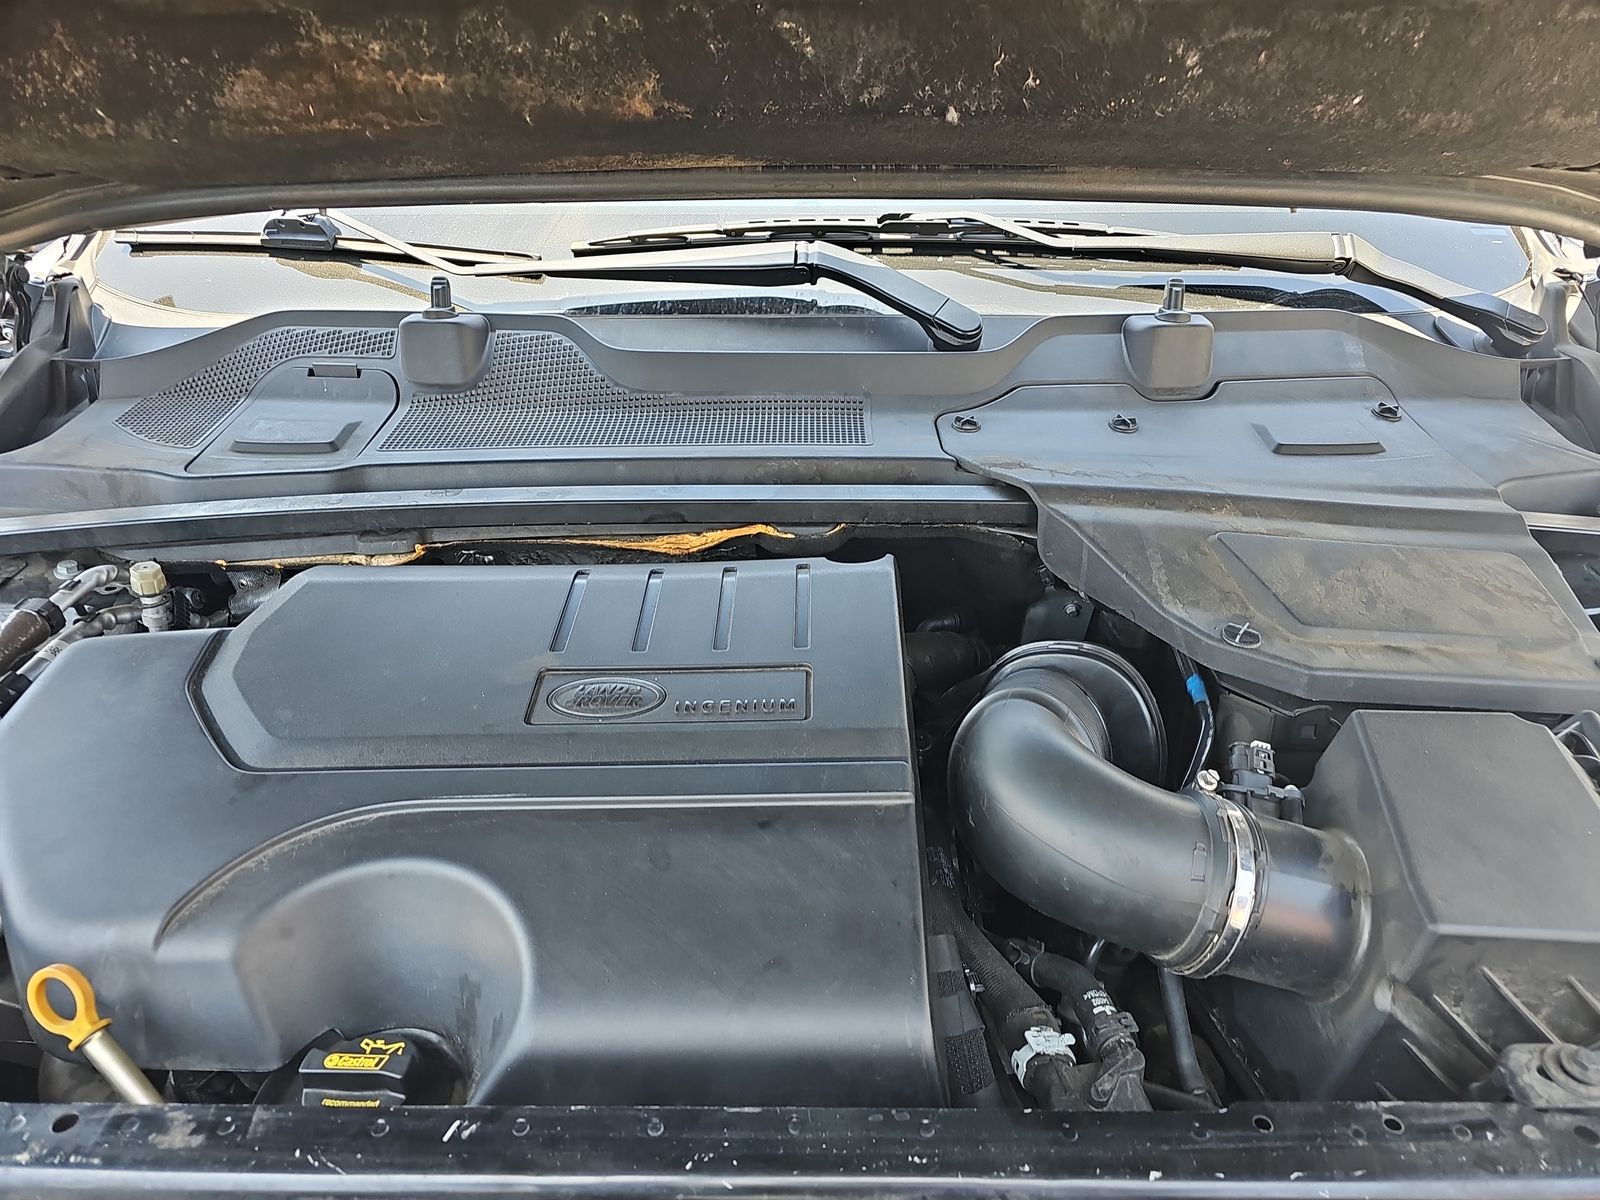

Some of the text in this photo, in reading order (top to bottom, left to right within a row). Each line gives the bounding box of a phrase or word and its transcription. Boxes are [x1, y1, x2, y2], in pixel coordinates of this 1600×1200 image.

[574, 684, 632, 697] LAND
[574, 694, 643, 709] ROVER
[674, 698, 796, 714] INGENIUM
[338, 1056, 379, 1067] Castrol
